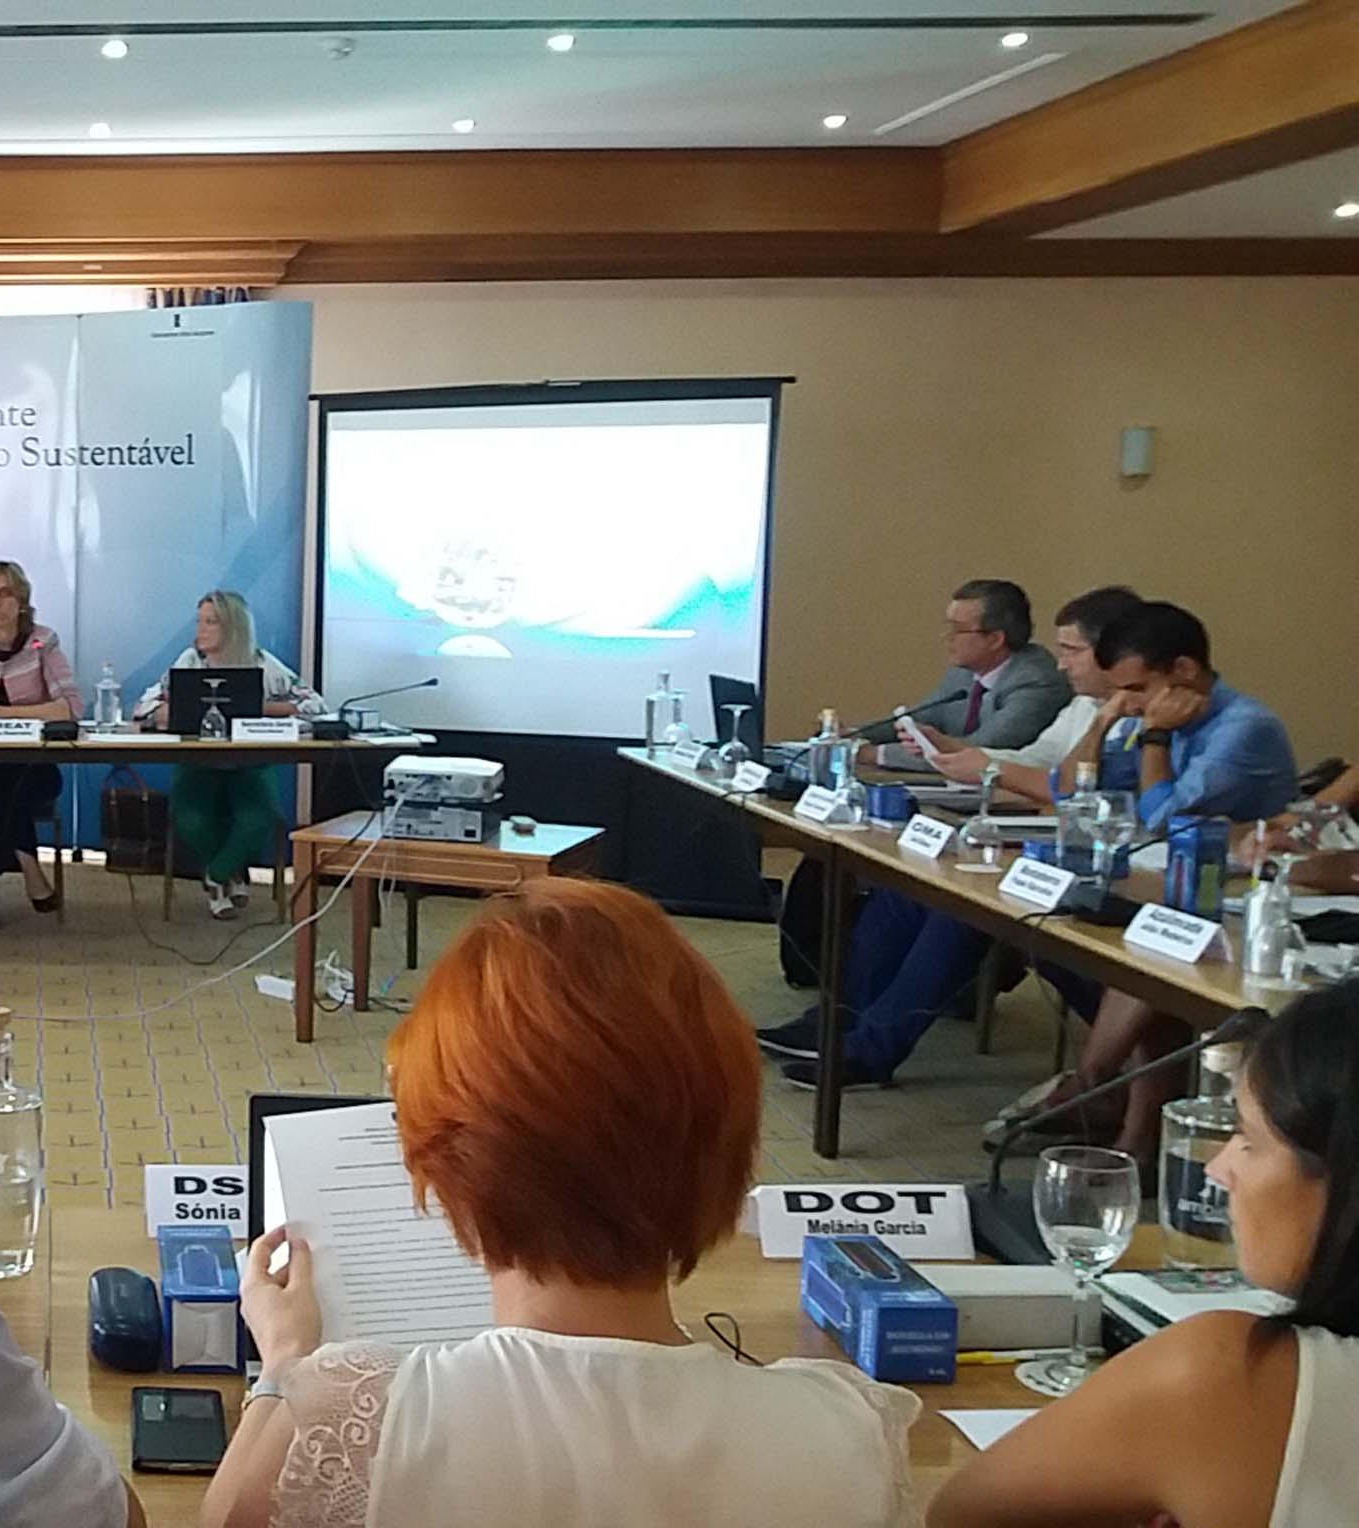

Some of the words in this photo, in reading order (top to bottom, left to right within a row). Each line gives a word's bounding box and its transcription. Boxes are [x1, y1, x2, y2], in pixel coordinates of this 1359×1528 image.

[21, 433, 195, 467] Sustentável
[175, 1202, 241, 1220] Sónia
[782, 1190, 947, 1214] DOT
[873, 1219, 927, 1235] Garcia
